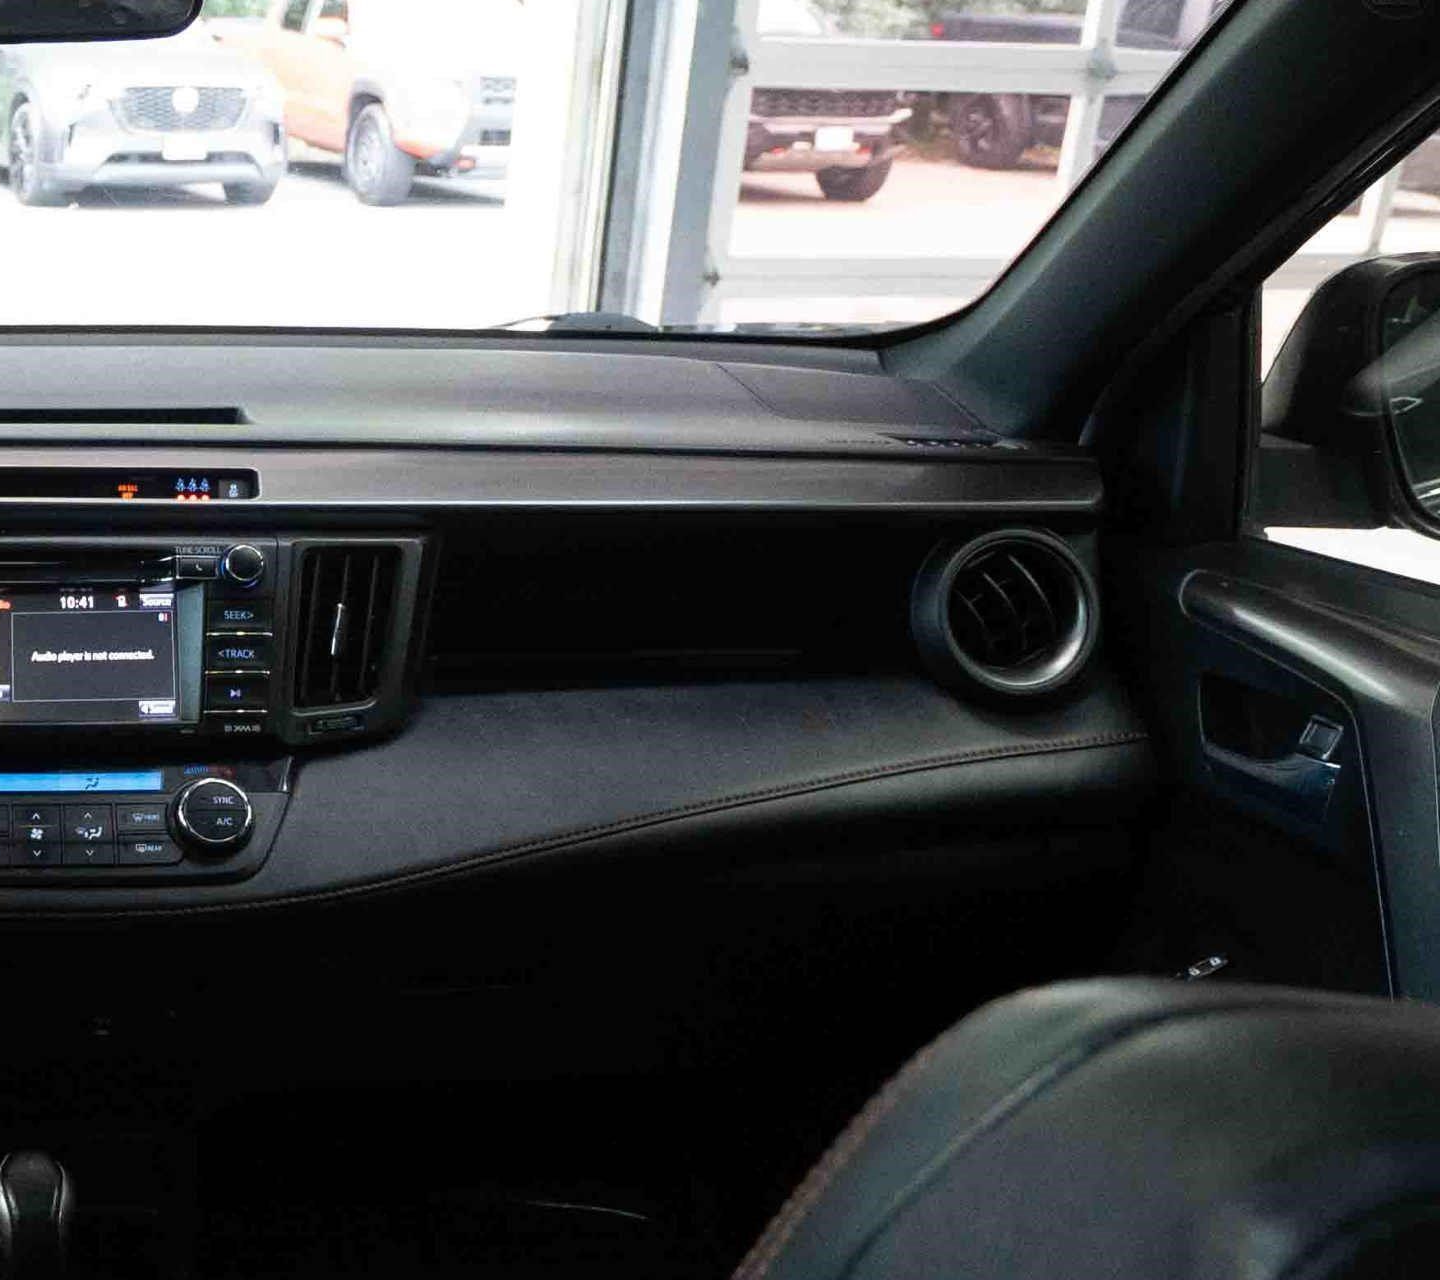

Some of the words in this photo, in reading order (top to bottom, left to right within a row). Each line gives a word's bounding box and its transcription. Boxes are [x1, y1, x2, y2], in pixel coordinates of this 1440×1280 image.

[59, 595, 94, 609] 10:41
[31, 651, 58, 662] Audio
[58, 651, 84, 663] player
[84, 651, 92, 660] is
[93, 651, 108, 660] not
[108, 649, 155, 660] connected.
[212, 796, 235, 805] SYNC
[216, 817, 233, 826] A/C
